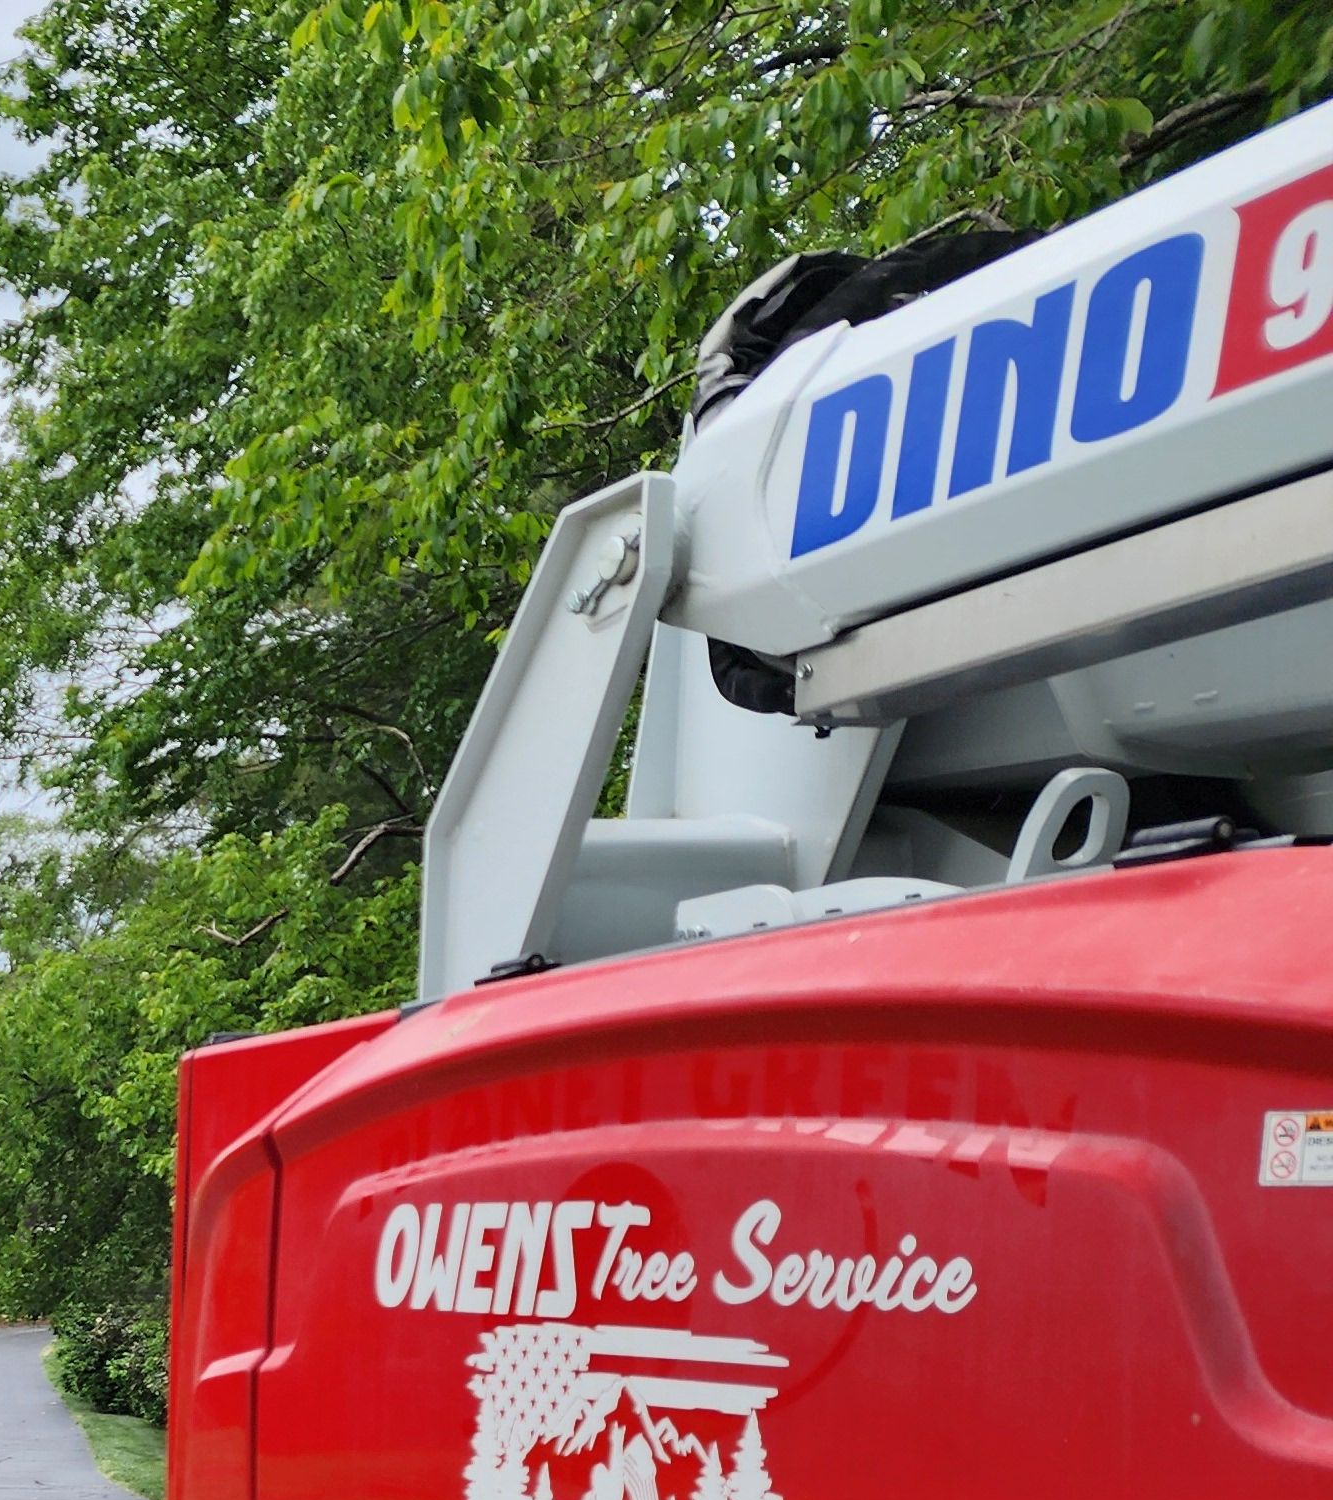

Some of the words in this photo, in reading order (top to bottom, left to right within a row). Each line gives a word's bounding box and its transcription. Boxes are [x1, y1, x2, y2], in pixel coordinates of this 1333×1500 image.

[790, 232, 1206, 560] DINO
[375, 1201, 595, 1319] OWENS
[593, 1200, 698, 1302] Tree
[713, 1199, 978, 1314] Service
